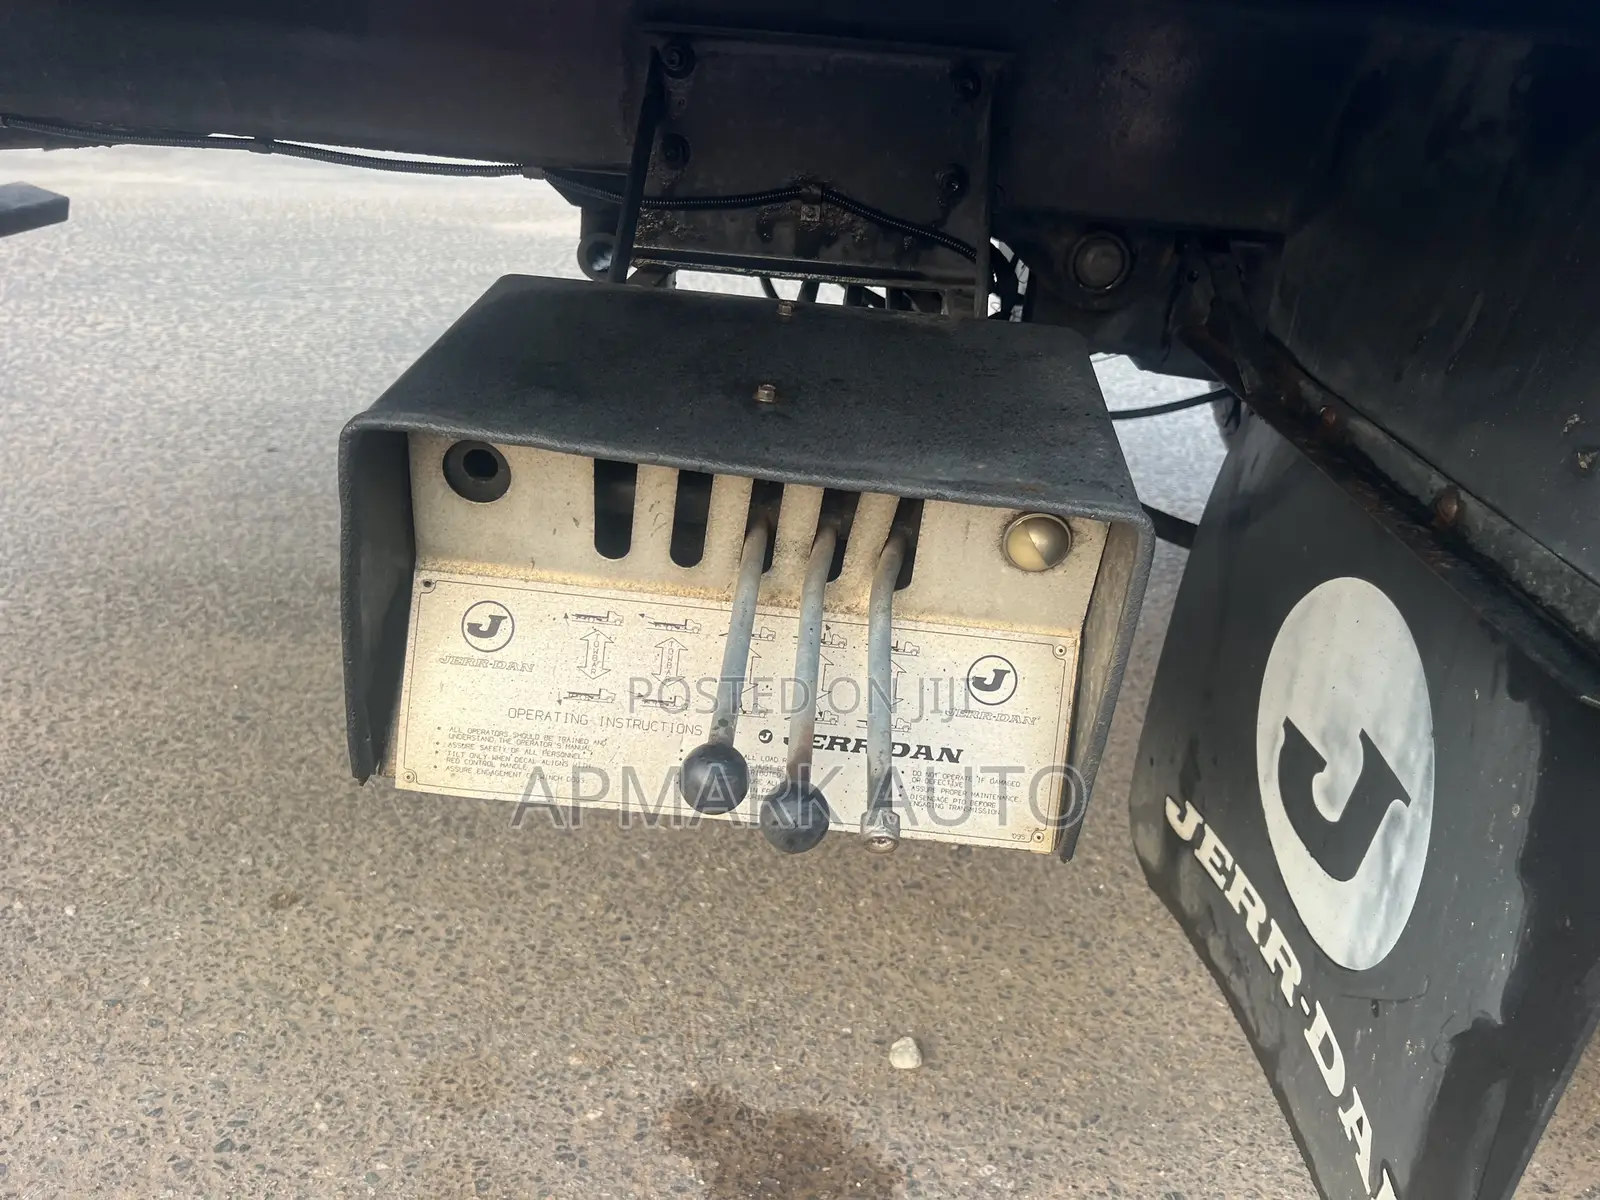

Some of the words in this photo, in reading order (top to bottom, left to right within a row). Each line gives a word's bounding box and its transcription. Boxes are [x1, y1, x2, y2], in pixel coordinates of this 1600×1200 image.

[439, 655, 535, 673] JERR-DAN
[508, 707, 589, 726] OPERATING
[600, 715, 703, 736] INSTRUCTIONS
[945, 708, 1040, 726] JERR-DAN
[448, 733, 494, 743] UNDERSTAND
[467, 728, 509, 737] OPERATORS
[512, 732, 540, 740] SHOULD
[558, 736, 590, 745] TRAINED
[593, 739, 607, 747] AND
[448, 742, 475, 750] ASSURE
[480, 744, 507, 753] SAFETY
[464, 758, 496, 767] CONTROL
[470, 752, 487, 760] ONLY
[491, 754, 511, 762] WHEN
[514, 756, 537, 764] DECAL
[541, 759, 569, 767] ALIGNS
[445, 765, 473, 774] ASSURE
[476, 768, 522, 778] ENGAGEMENT
[942, 773, 973, 782] OPERATE
[940, 788, 968, 797] PROPER
